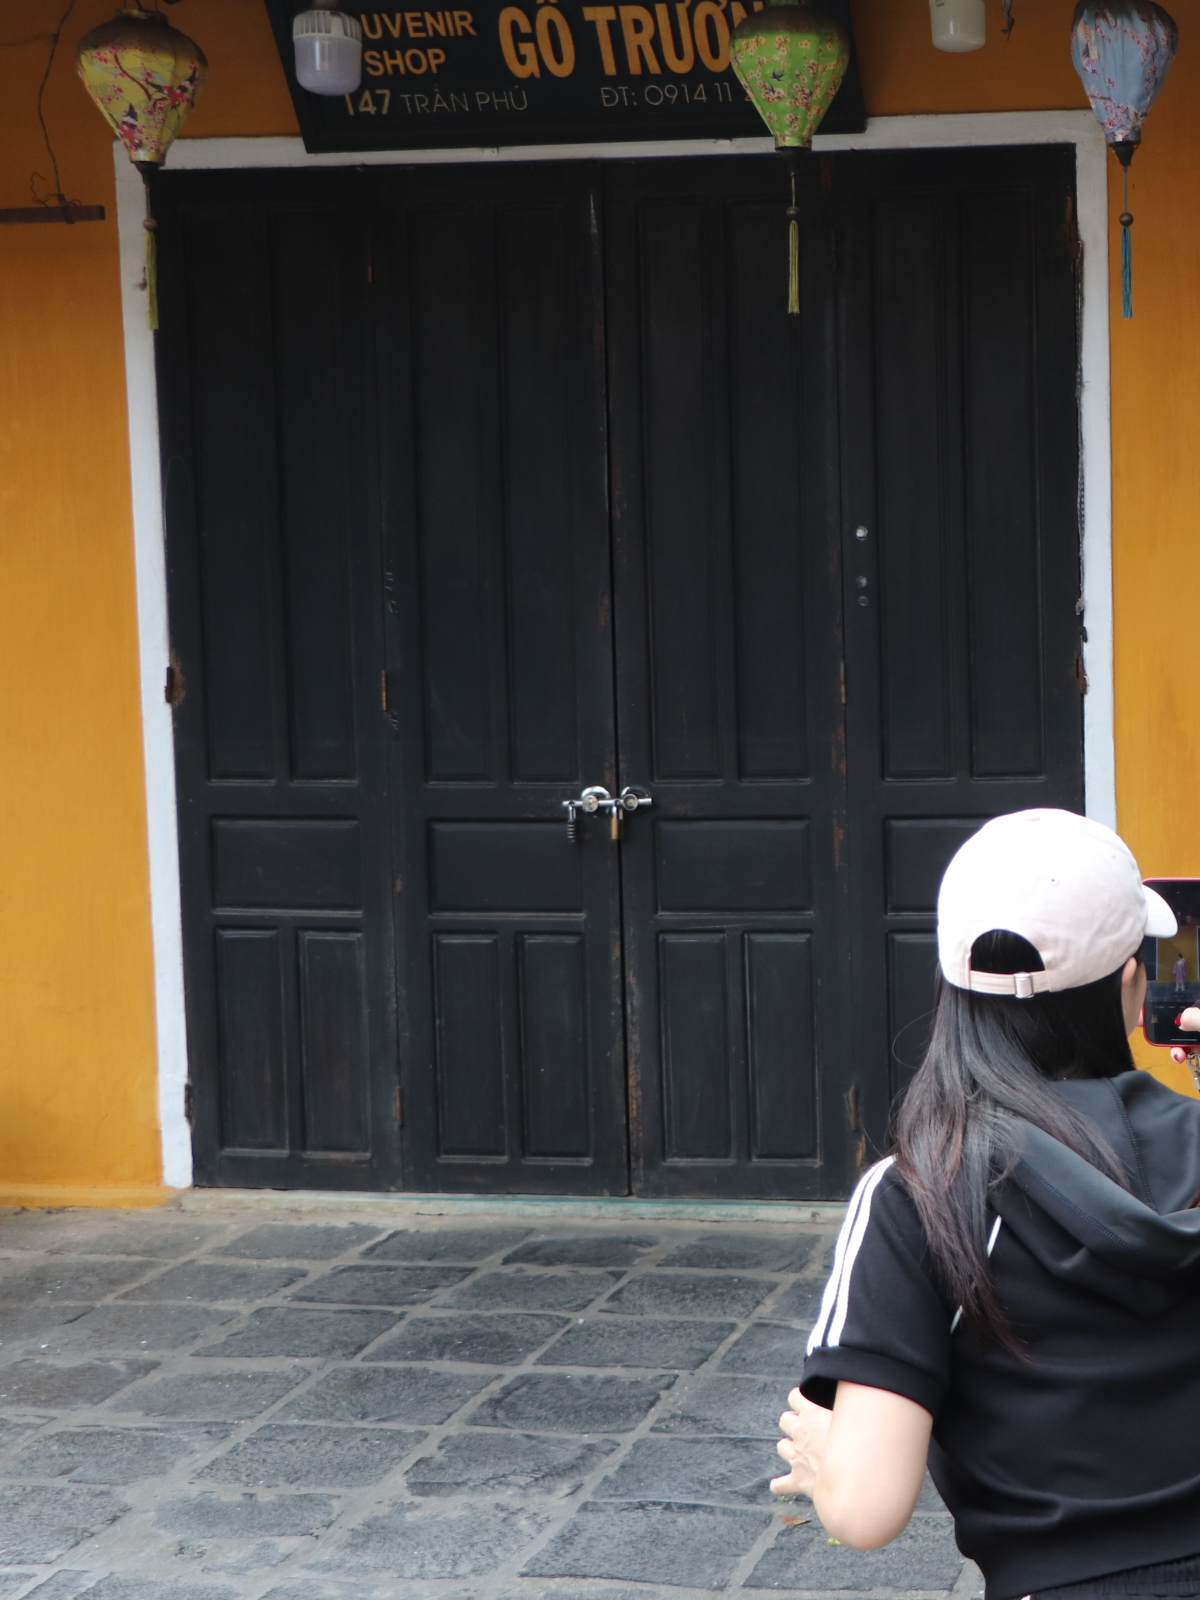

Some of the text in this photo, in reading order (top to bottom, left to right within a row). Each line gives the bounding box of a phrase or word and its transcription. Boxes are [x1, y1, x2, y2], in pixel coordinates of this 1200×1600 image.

[361, 10, 477, 40] UVENIR
[363, 48, 446, 77] SHOP
[343, 82, 528, 116] 147 TRẦN PHÚ
[600, 82, 733, 107] ĐT: 0914 11
